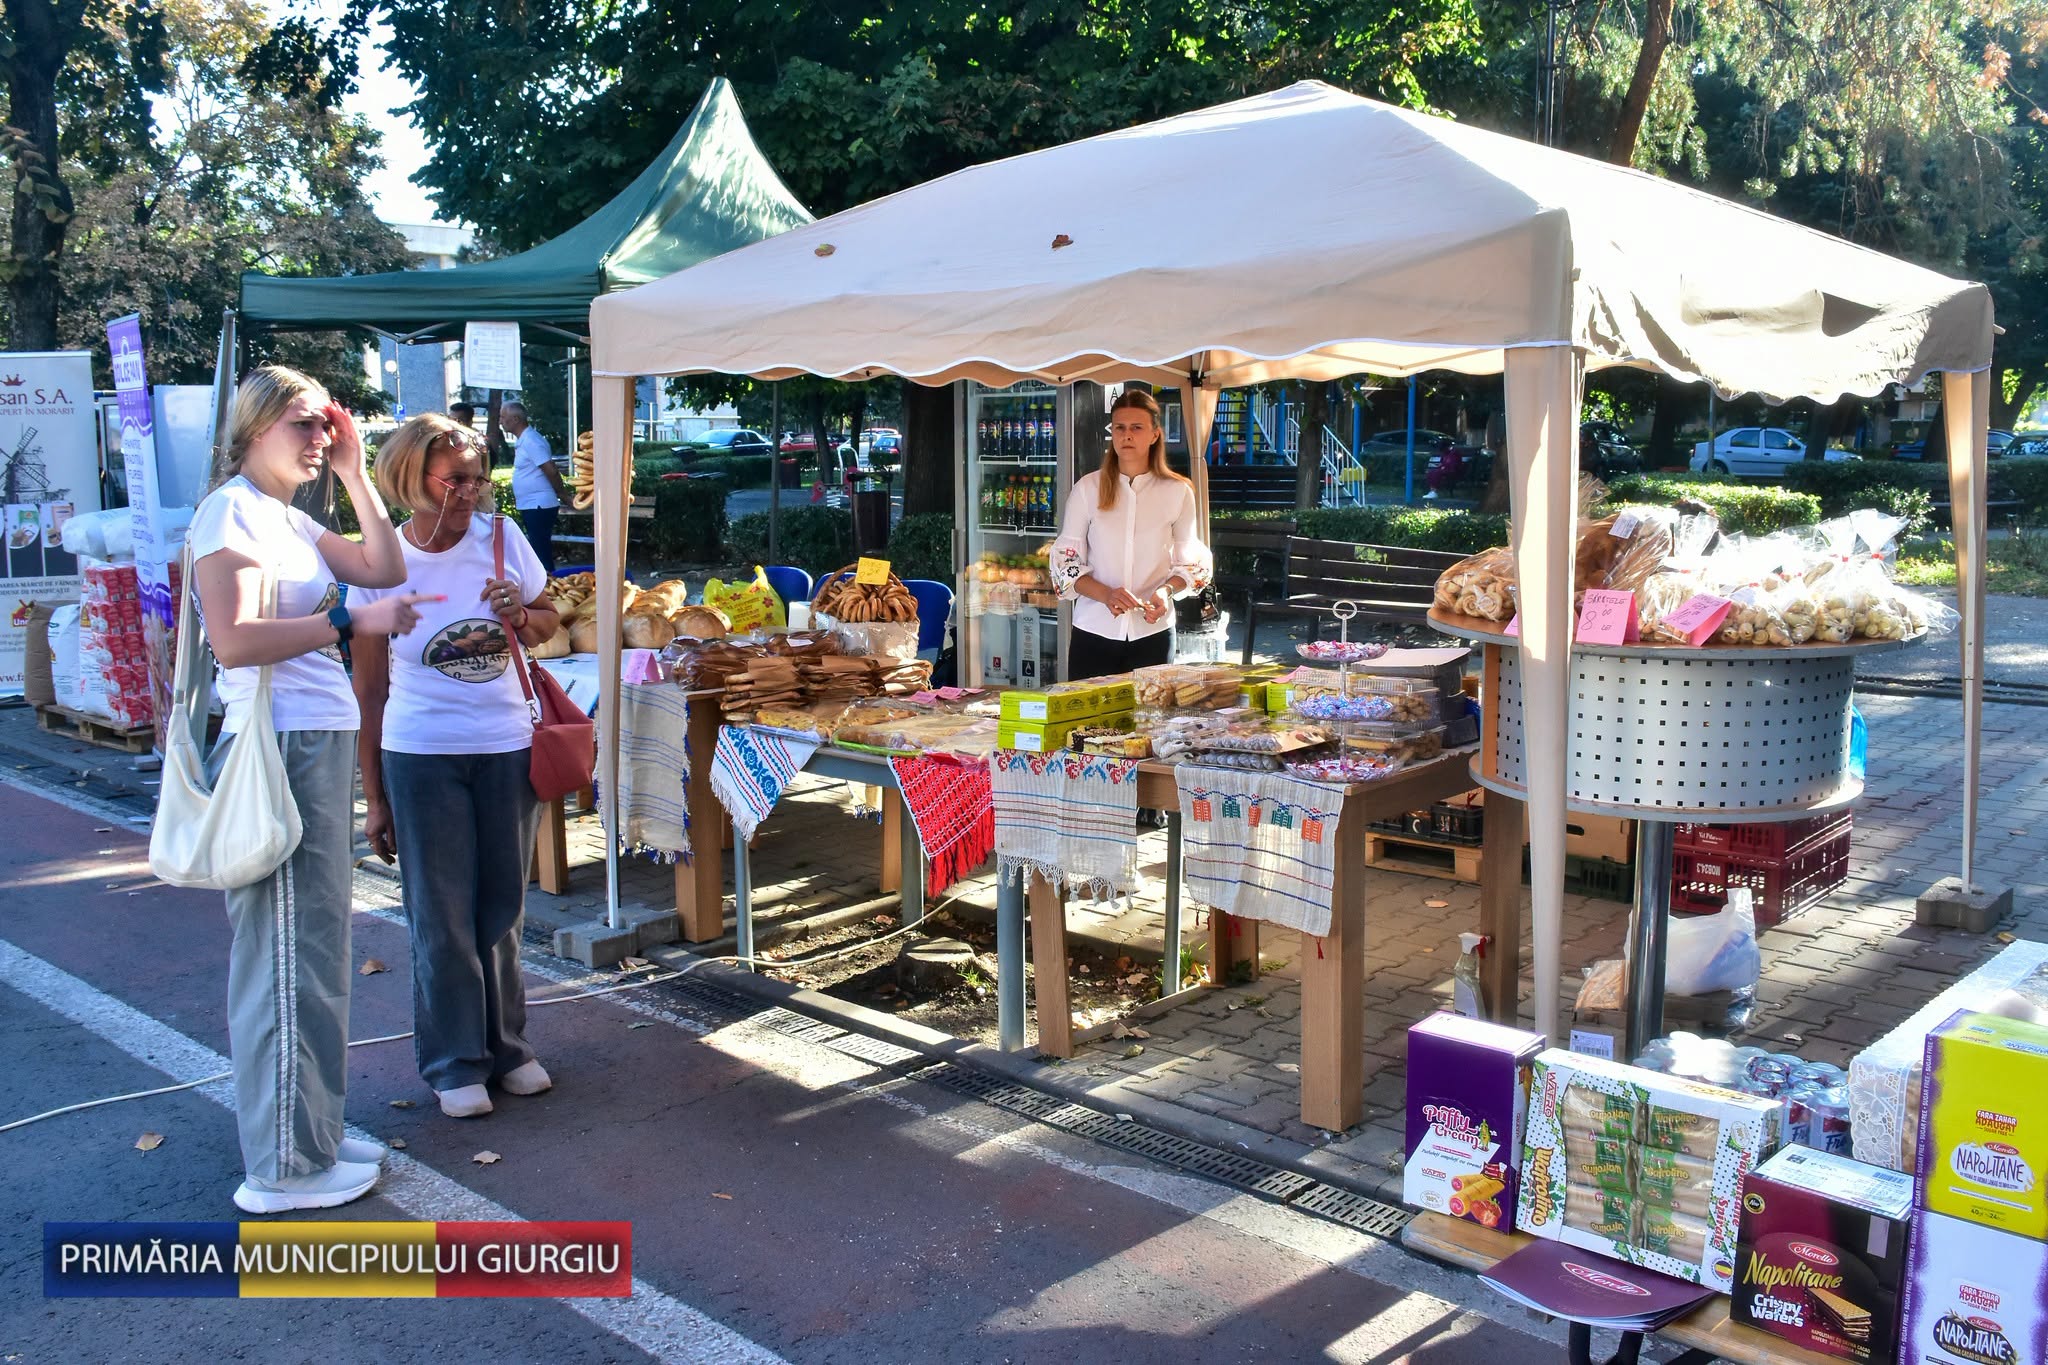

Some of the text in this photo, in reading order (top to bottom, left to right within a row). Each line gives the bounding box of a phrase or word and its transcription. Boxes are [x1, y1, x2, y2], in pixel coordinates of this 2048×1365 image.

[34, 388, 73, 405] S.A.
[396, 404, 404, 414] P
[1580, 611, 1597, 631] 8
[1544, 1071, 1557, 1119] WAFRO
[1422, 1104, 1478, 1135] Puffy
[1975, 1118, 2017, 1133] ADAUGAT
[1977, 1110, 2017, 1126] FARA ZAHAR
[1430, 1122, 1481, 1150] Cream
[1956, 1147, 2025, 1183] NAPOLITANE
[1713, 1197, 1729, 1250] Spirale
[1793, 1244, 1833, 1264] Morello
[1743, 1250, 1844, 1295] Napolitane
[1959, 1293, 2000, 1311] ADAUGAT
[1960, 1285, 2000, 1302] FARA ZAHAR
[1754, 1293, 1802, 1318] Crispy
[1750, 1305, 1804, 1328] Wafers
[1857, 1344, 1871, 1354] CACAO
[1939, 1319, 2008, 1360] NAPOLITANE
